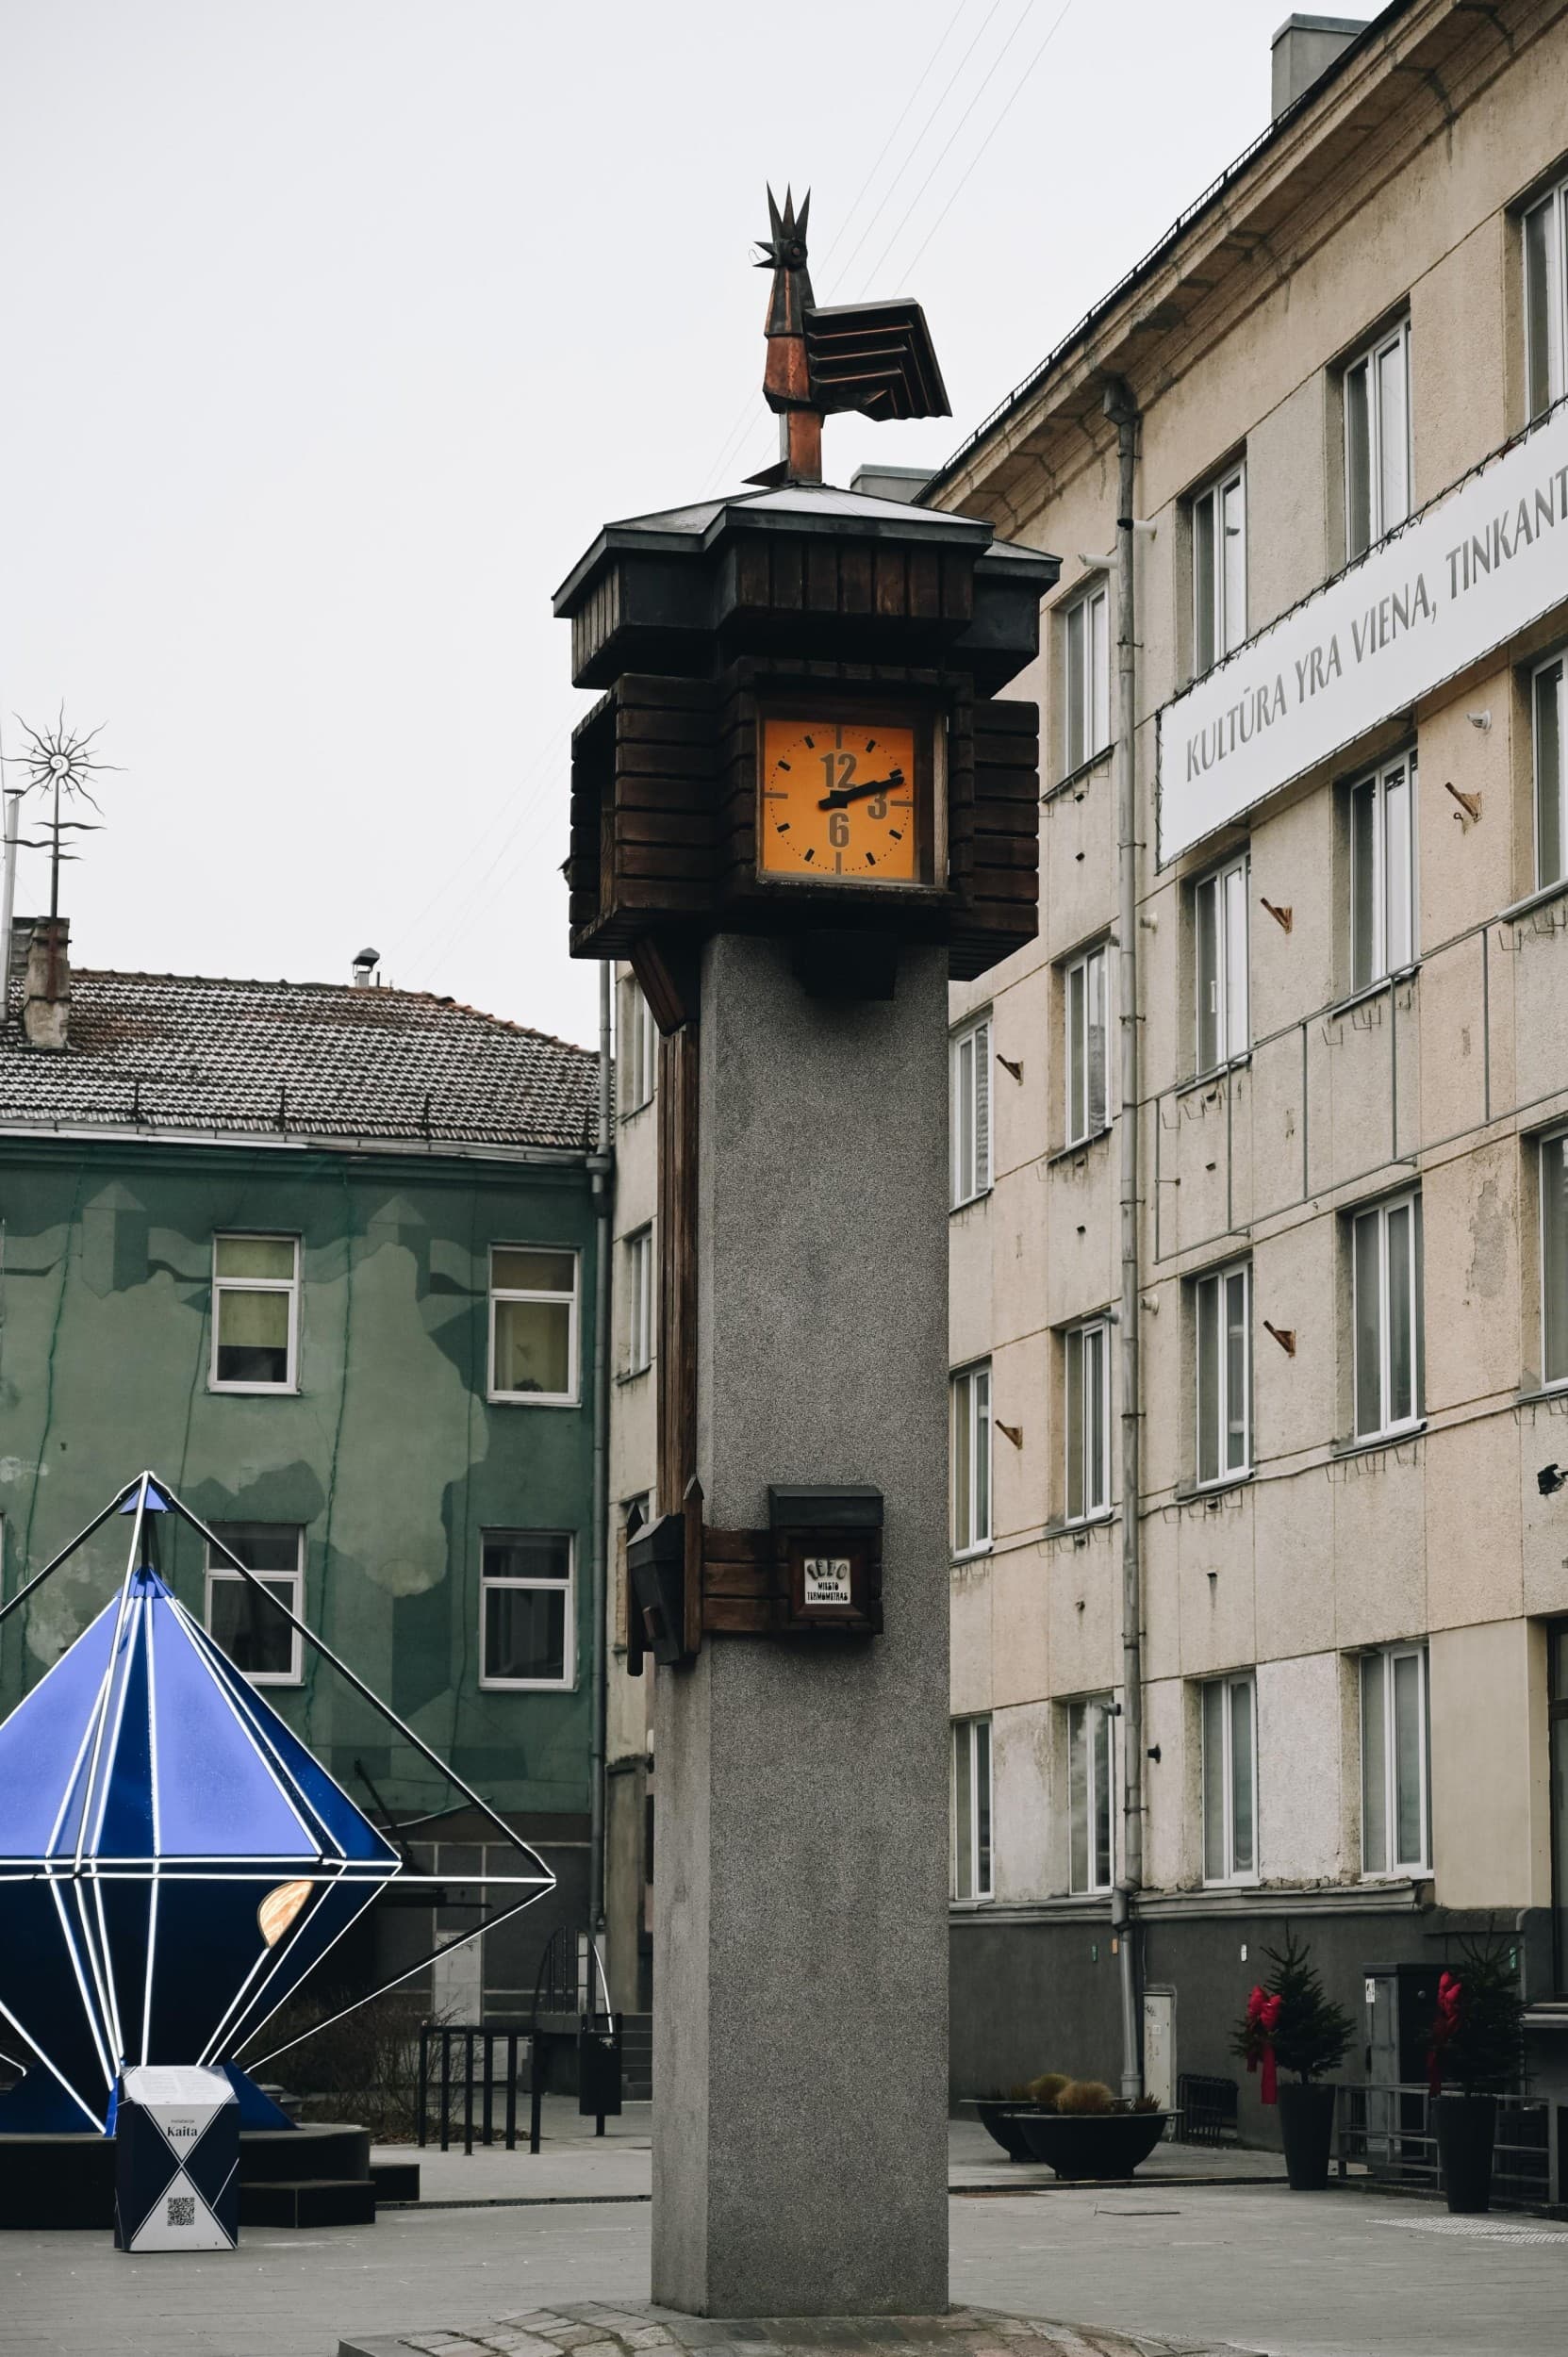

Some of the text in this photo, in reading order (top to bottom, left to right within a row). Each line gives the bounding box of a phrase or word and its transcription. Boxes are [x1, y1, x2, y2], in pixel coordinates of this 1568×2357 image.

[1186, 674, 1288, 783] KULTŪRA
[1294, 634, 1343, 704] YRA
[1350, 572, 1438, 664] VIENA,
[818, 752, 857, 787] 12
[867, 790, 887, 820] 3
[829, 812, 850, 848] 6
[167, 2126, 198, 2136] Kaita
